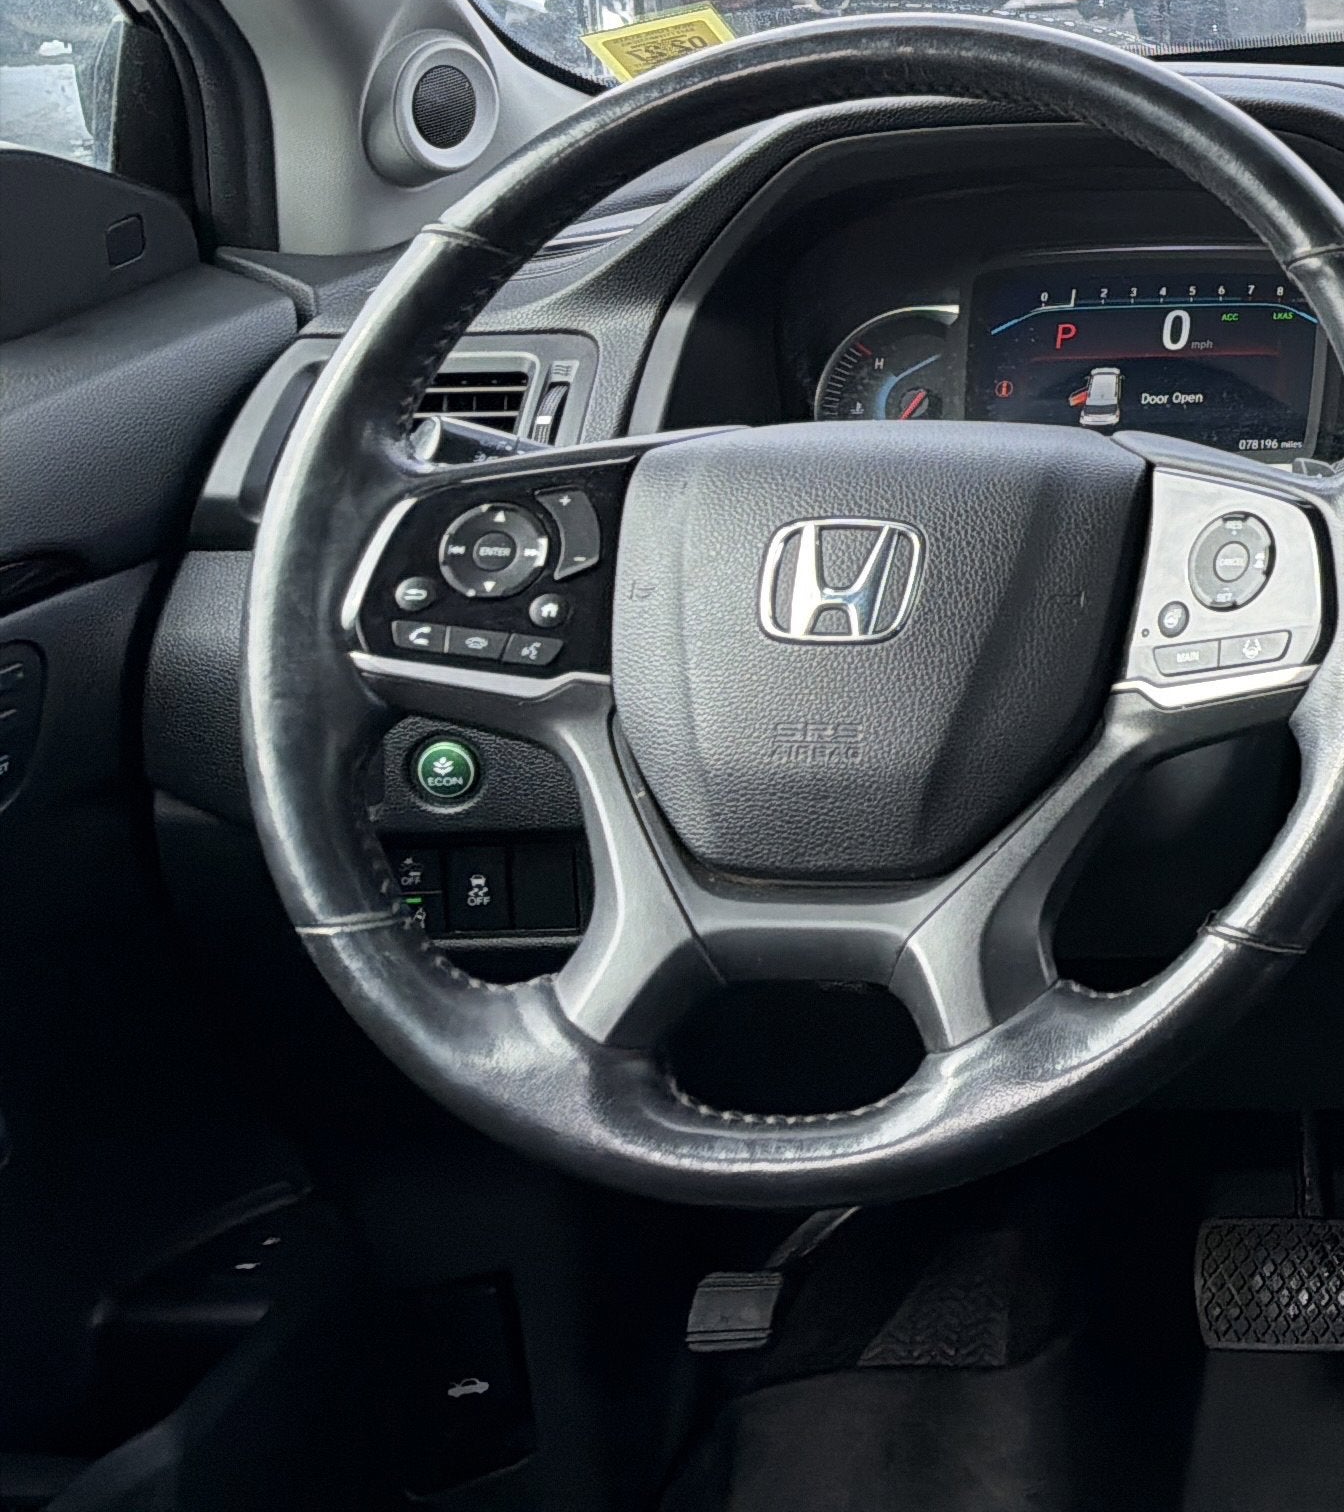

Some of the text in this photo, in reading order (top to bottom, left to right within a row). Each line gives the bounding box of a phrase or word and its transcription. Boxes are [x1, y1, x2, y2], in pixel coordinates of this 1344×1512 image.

[1041, 285, 1284, 302] 0 2 3 4 5 6 7 8
[1221, 312, 1240, 321] ACC
[1272, 311, 1294, 320] LKAS
[1162, 309, 1214, 351] 0 mph
[1055, 323, 1078, 350] P
[1141, 391, 1204, 405] Door Open
[1238, 439, 1279, 450] 078196
[478, 546, 512, 557] ENTER
[427, 776, 464, 787] ECON
[401, 876, 421, 886] OFF
[467, 896, 491, 906] OFF
